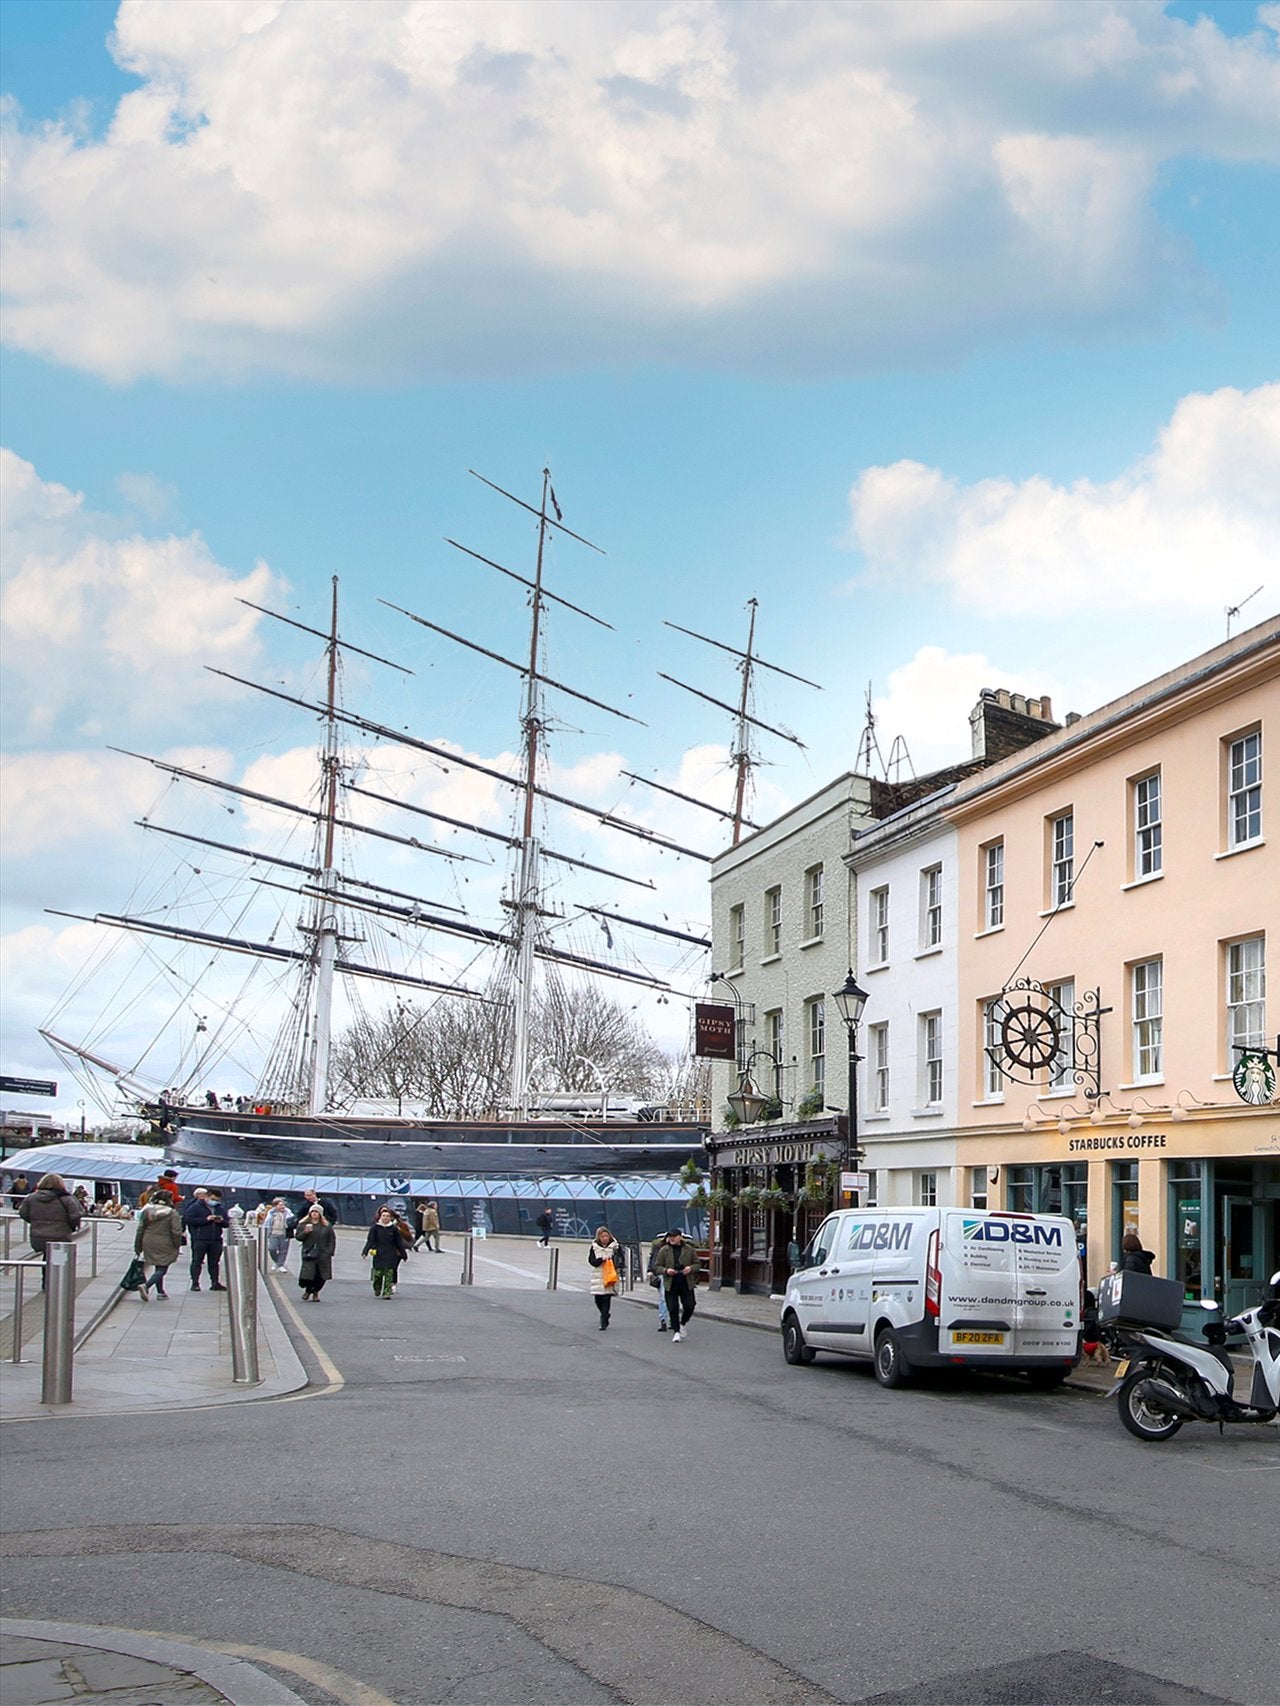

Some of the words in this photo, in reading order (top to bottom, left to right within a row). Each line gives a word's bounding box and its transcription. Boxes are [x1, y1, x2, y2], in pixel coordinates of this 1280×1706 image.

[698, 1018, 732, 1027] GIPSY
[700, 1025, 731, 1034] MOTH
[1069, 1136, 1125, 1151] STARBUCKS
[1127, 1135, 1166, 1148] COFFEE
[734, 1147, 771, 1165] GIPSY
[773, 1143, 811, 1163] MOTH
[858, 1223, 913, 1250] D&M
[984, 1221, 1062, 1247] D&M
[948, 1296, 1075, 1307] www.dandmgroup.co.uk
[956, 1332, 980, 1342] BF20
[982, 1333, 1000, 1342] ZFA
